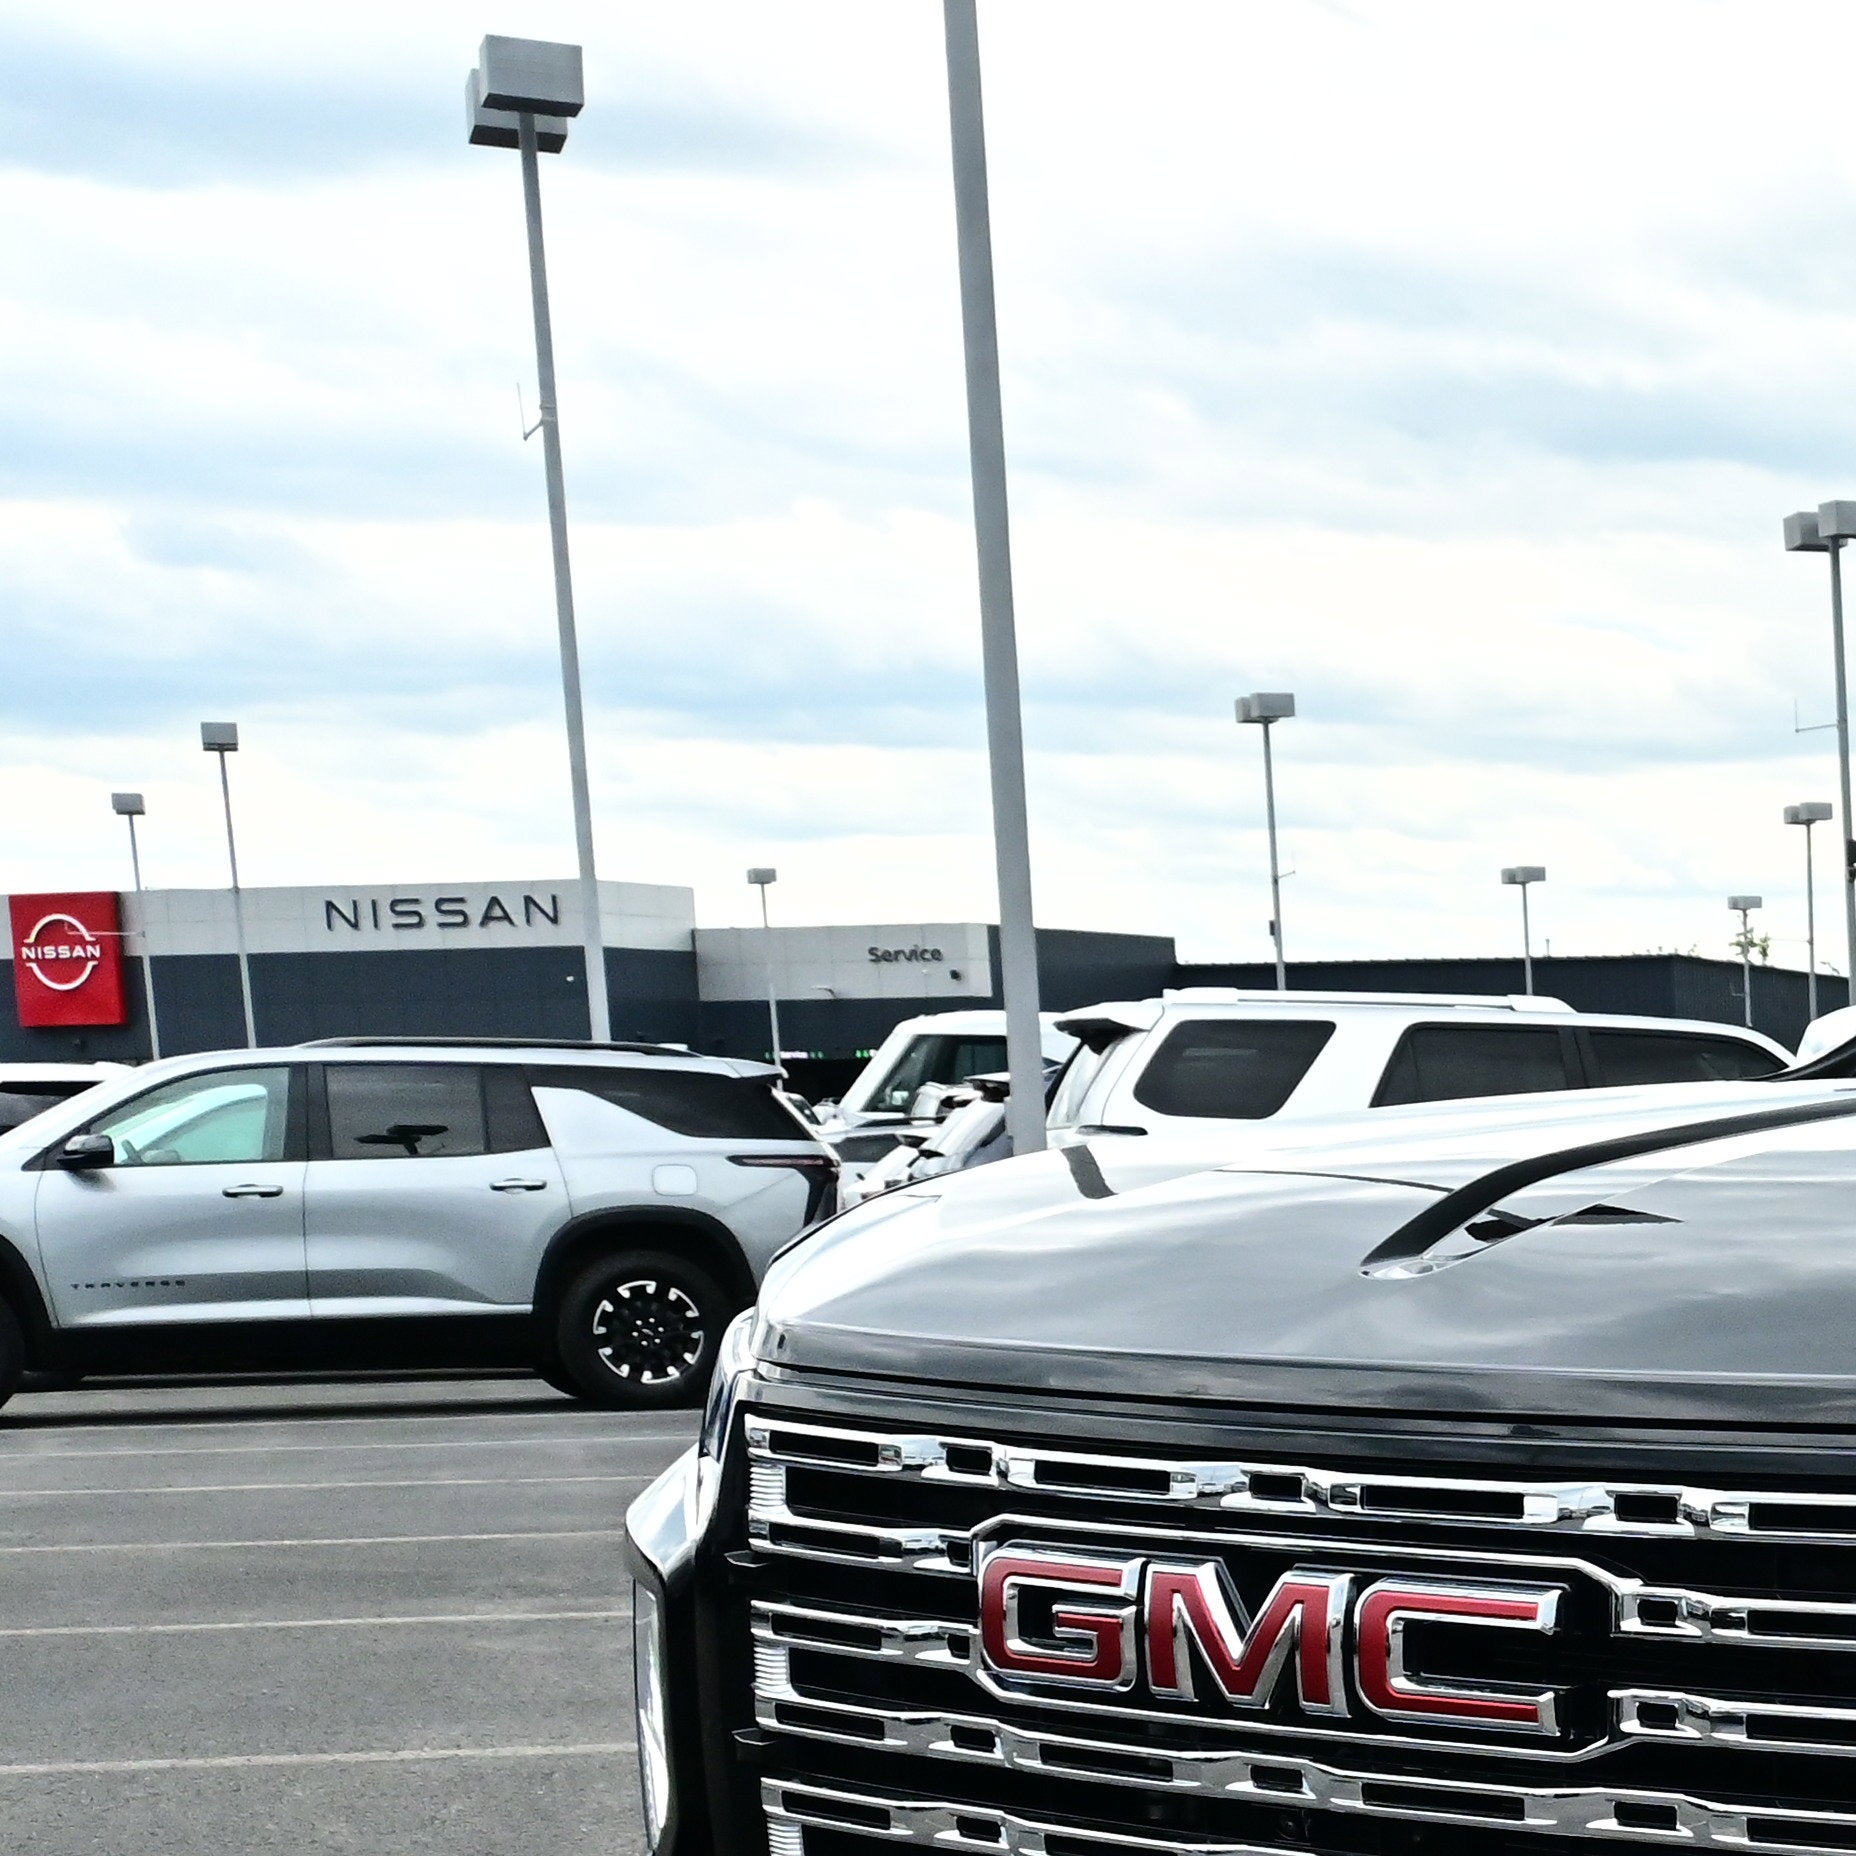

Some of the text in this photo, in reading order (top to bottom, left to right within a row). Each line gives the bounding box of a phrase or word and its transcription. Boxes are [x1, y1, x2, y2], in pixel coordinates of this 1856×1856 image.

[324, 893, 560, 931] NISSAN
[21, 943, 100, 960] NISSAN
[868, 944, 944, 963] Service
[977, 1549, 1565, 1736] GMC
